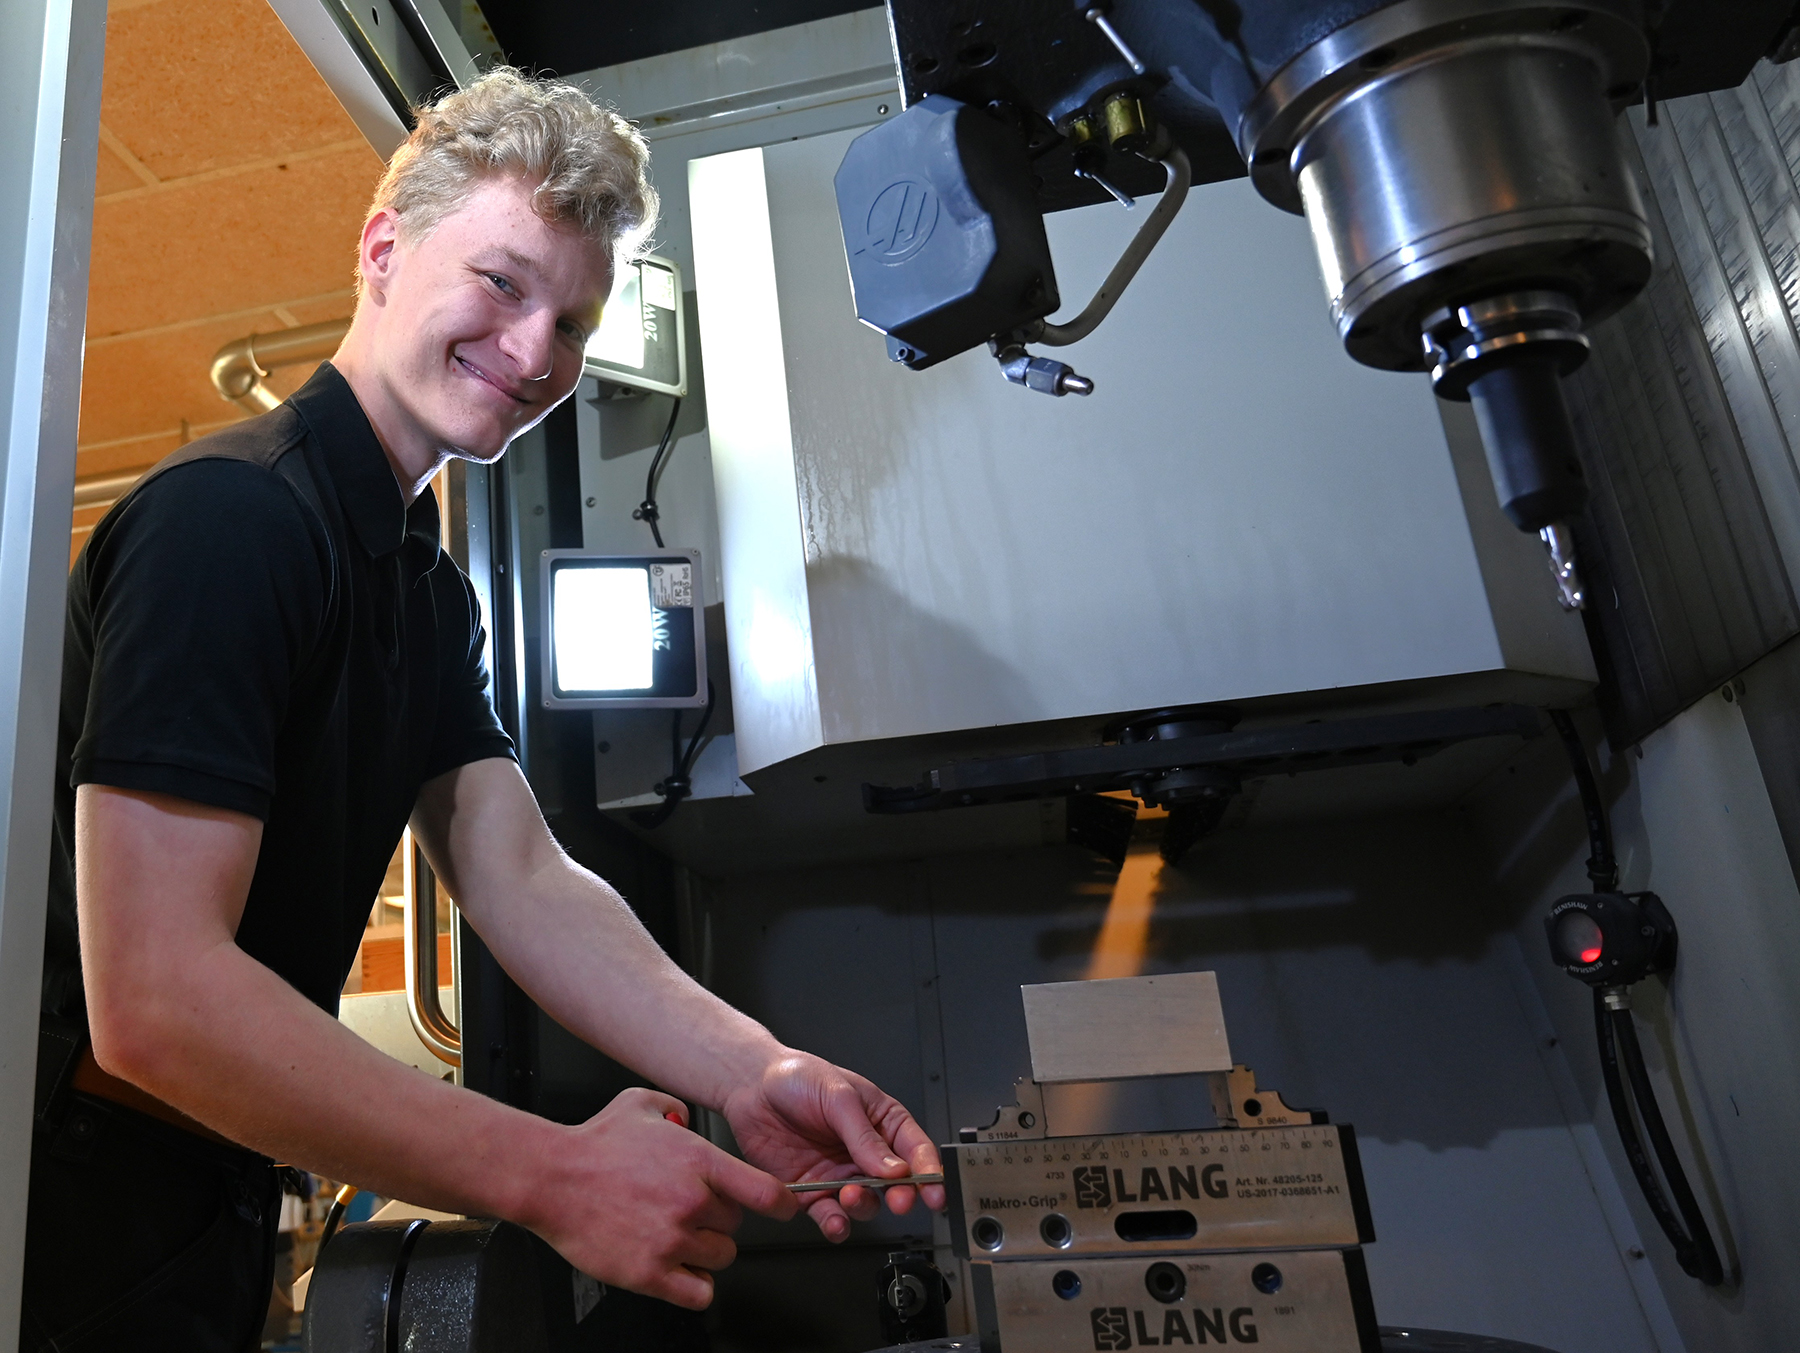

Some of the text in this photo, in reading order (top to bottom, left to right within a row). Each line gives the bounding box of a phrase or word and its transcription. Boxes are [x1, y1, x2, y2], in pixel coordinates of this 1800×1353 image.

[642, 301, 658, 342] 20W
[652, 606, 670, 651] 20W
[1553, 901, 1588, 915] RENISHAW
[1568, 960, 1603, 973] RENISHAW
[988, 1131, 1018, 1140] S 11844
[1004, 1156, 1013, 1164] 70
[1044, 1154, 1053, 1162] 50
[1061, 1153, 1070, 1161] 40
[1081, 1152, 1091, 1160] 30
[1100, 1151, 1109, 1159] 20
[1120, 1150, 1129, 1158] 10
[1142, 1149, 1147, 1157] 0
[1159, 1148, 1168, 1156] 10
[1179, 1147, 1189, 1155] 20
[1200, 1146, 1210, 1154] 30
[1219, 1145, 1228, 1153] 40
[1240, 1144, 1249, 1152] 50
[1261, 1143, 1271, 1151] 60
[1281, 1142, 1290, 1150] 70
[1301, 1141, 1312, 1149] 80
[1323, 1140, 1333, 1148] 90
[1046, 1171, 1065, 1180] 4733
[1113, 1163, 1229, 1202] LANG
[1235, 1174, 1323, 1186] Art. Nr. 48205-125
[1134, 1306, 1258, 1346] LANG
